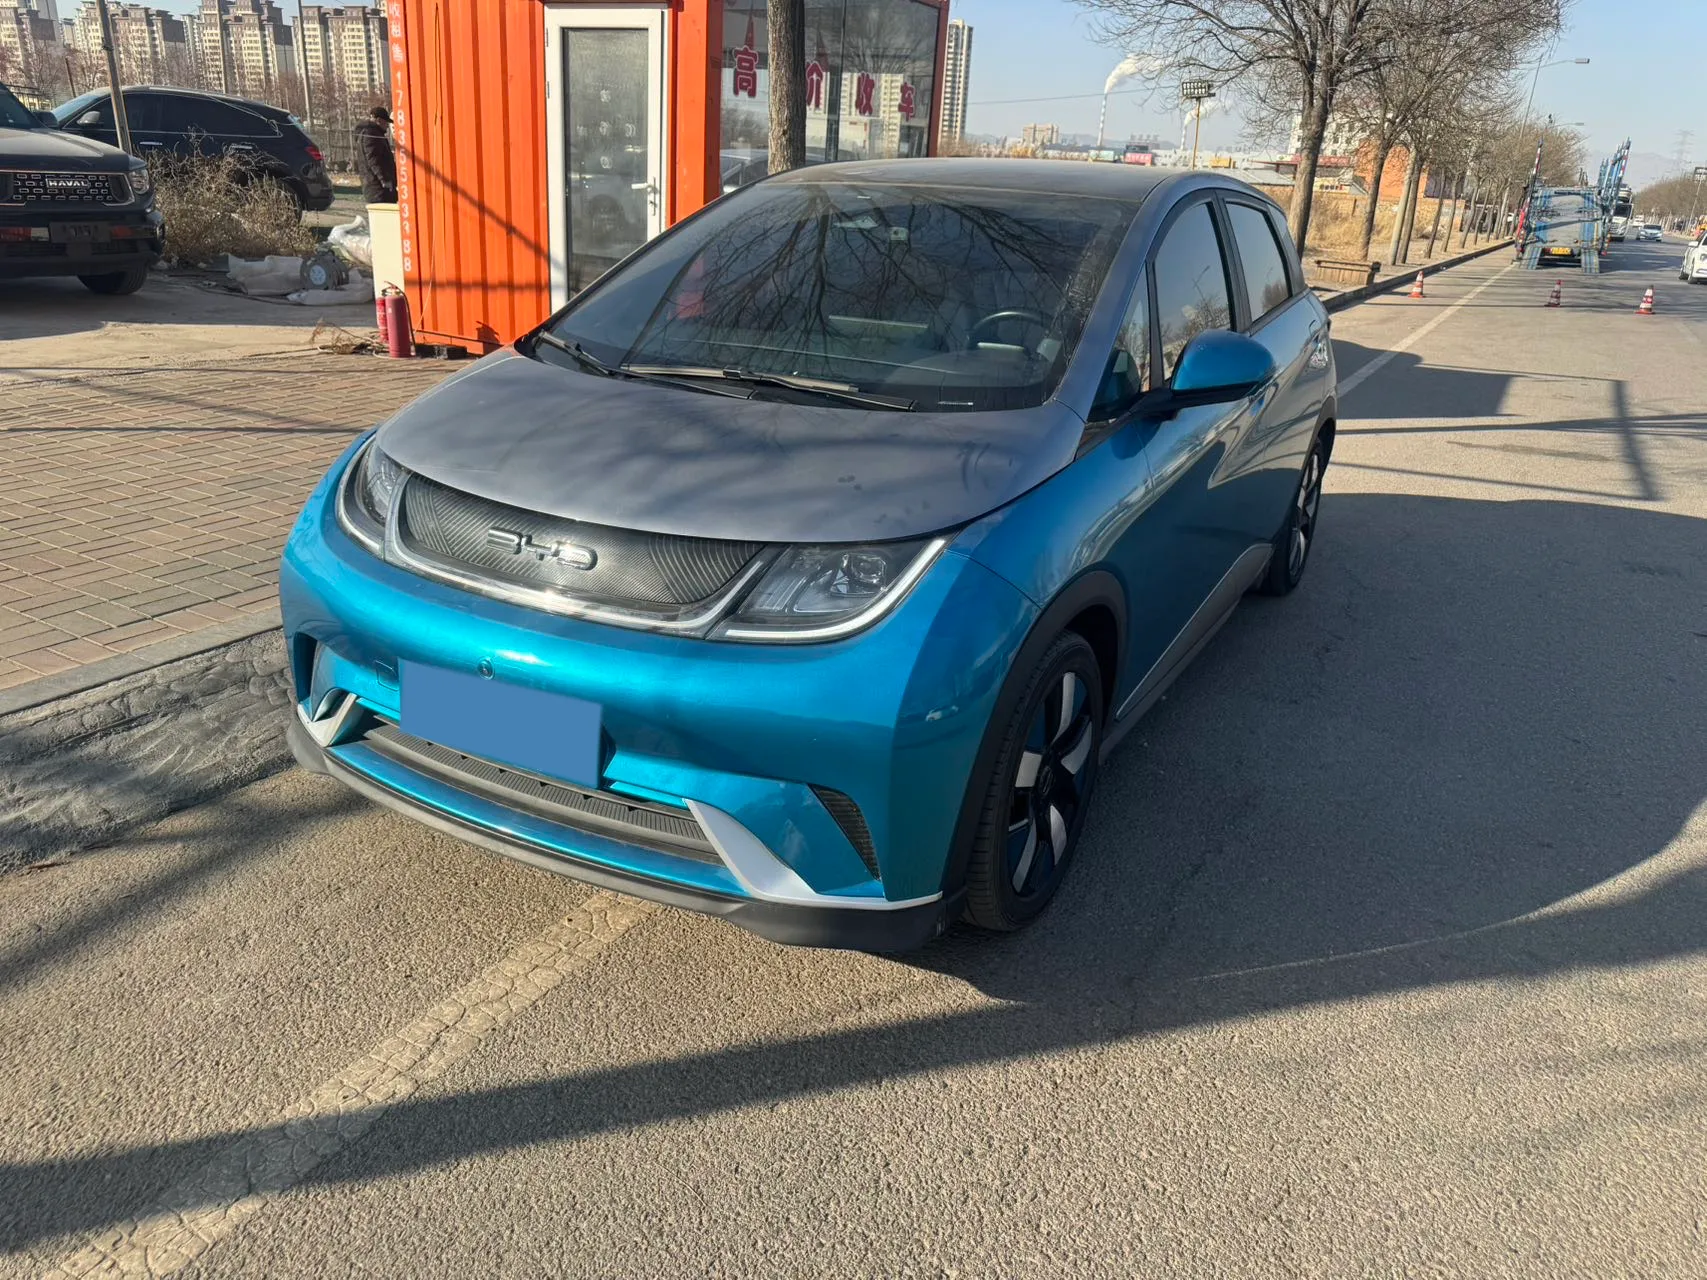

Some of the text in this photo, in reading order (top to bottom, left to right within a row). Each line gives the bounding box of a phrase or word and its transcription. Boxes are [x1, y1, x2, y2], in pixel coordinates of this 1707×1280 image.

[733, 45, 916, 122] 高价收车
[486, 527, 598, 571] BYD
